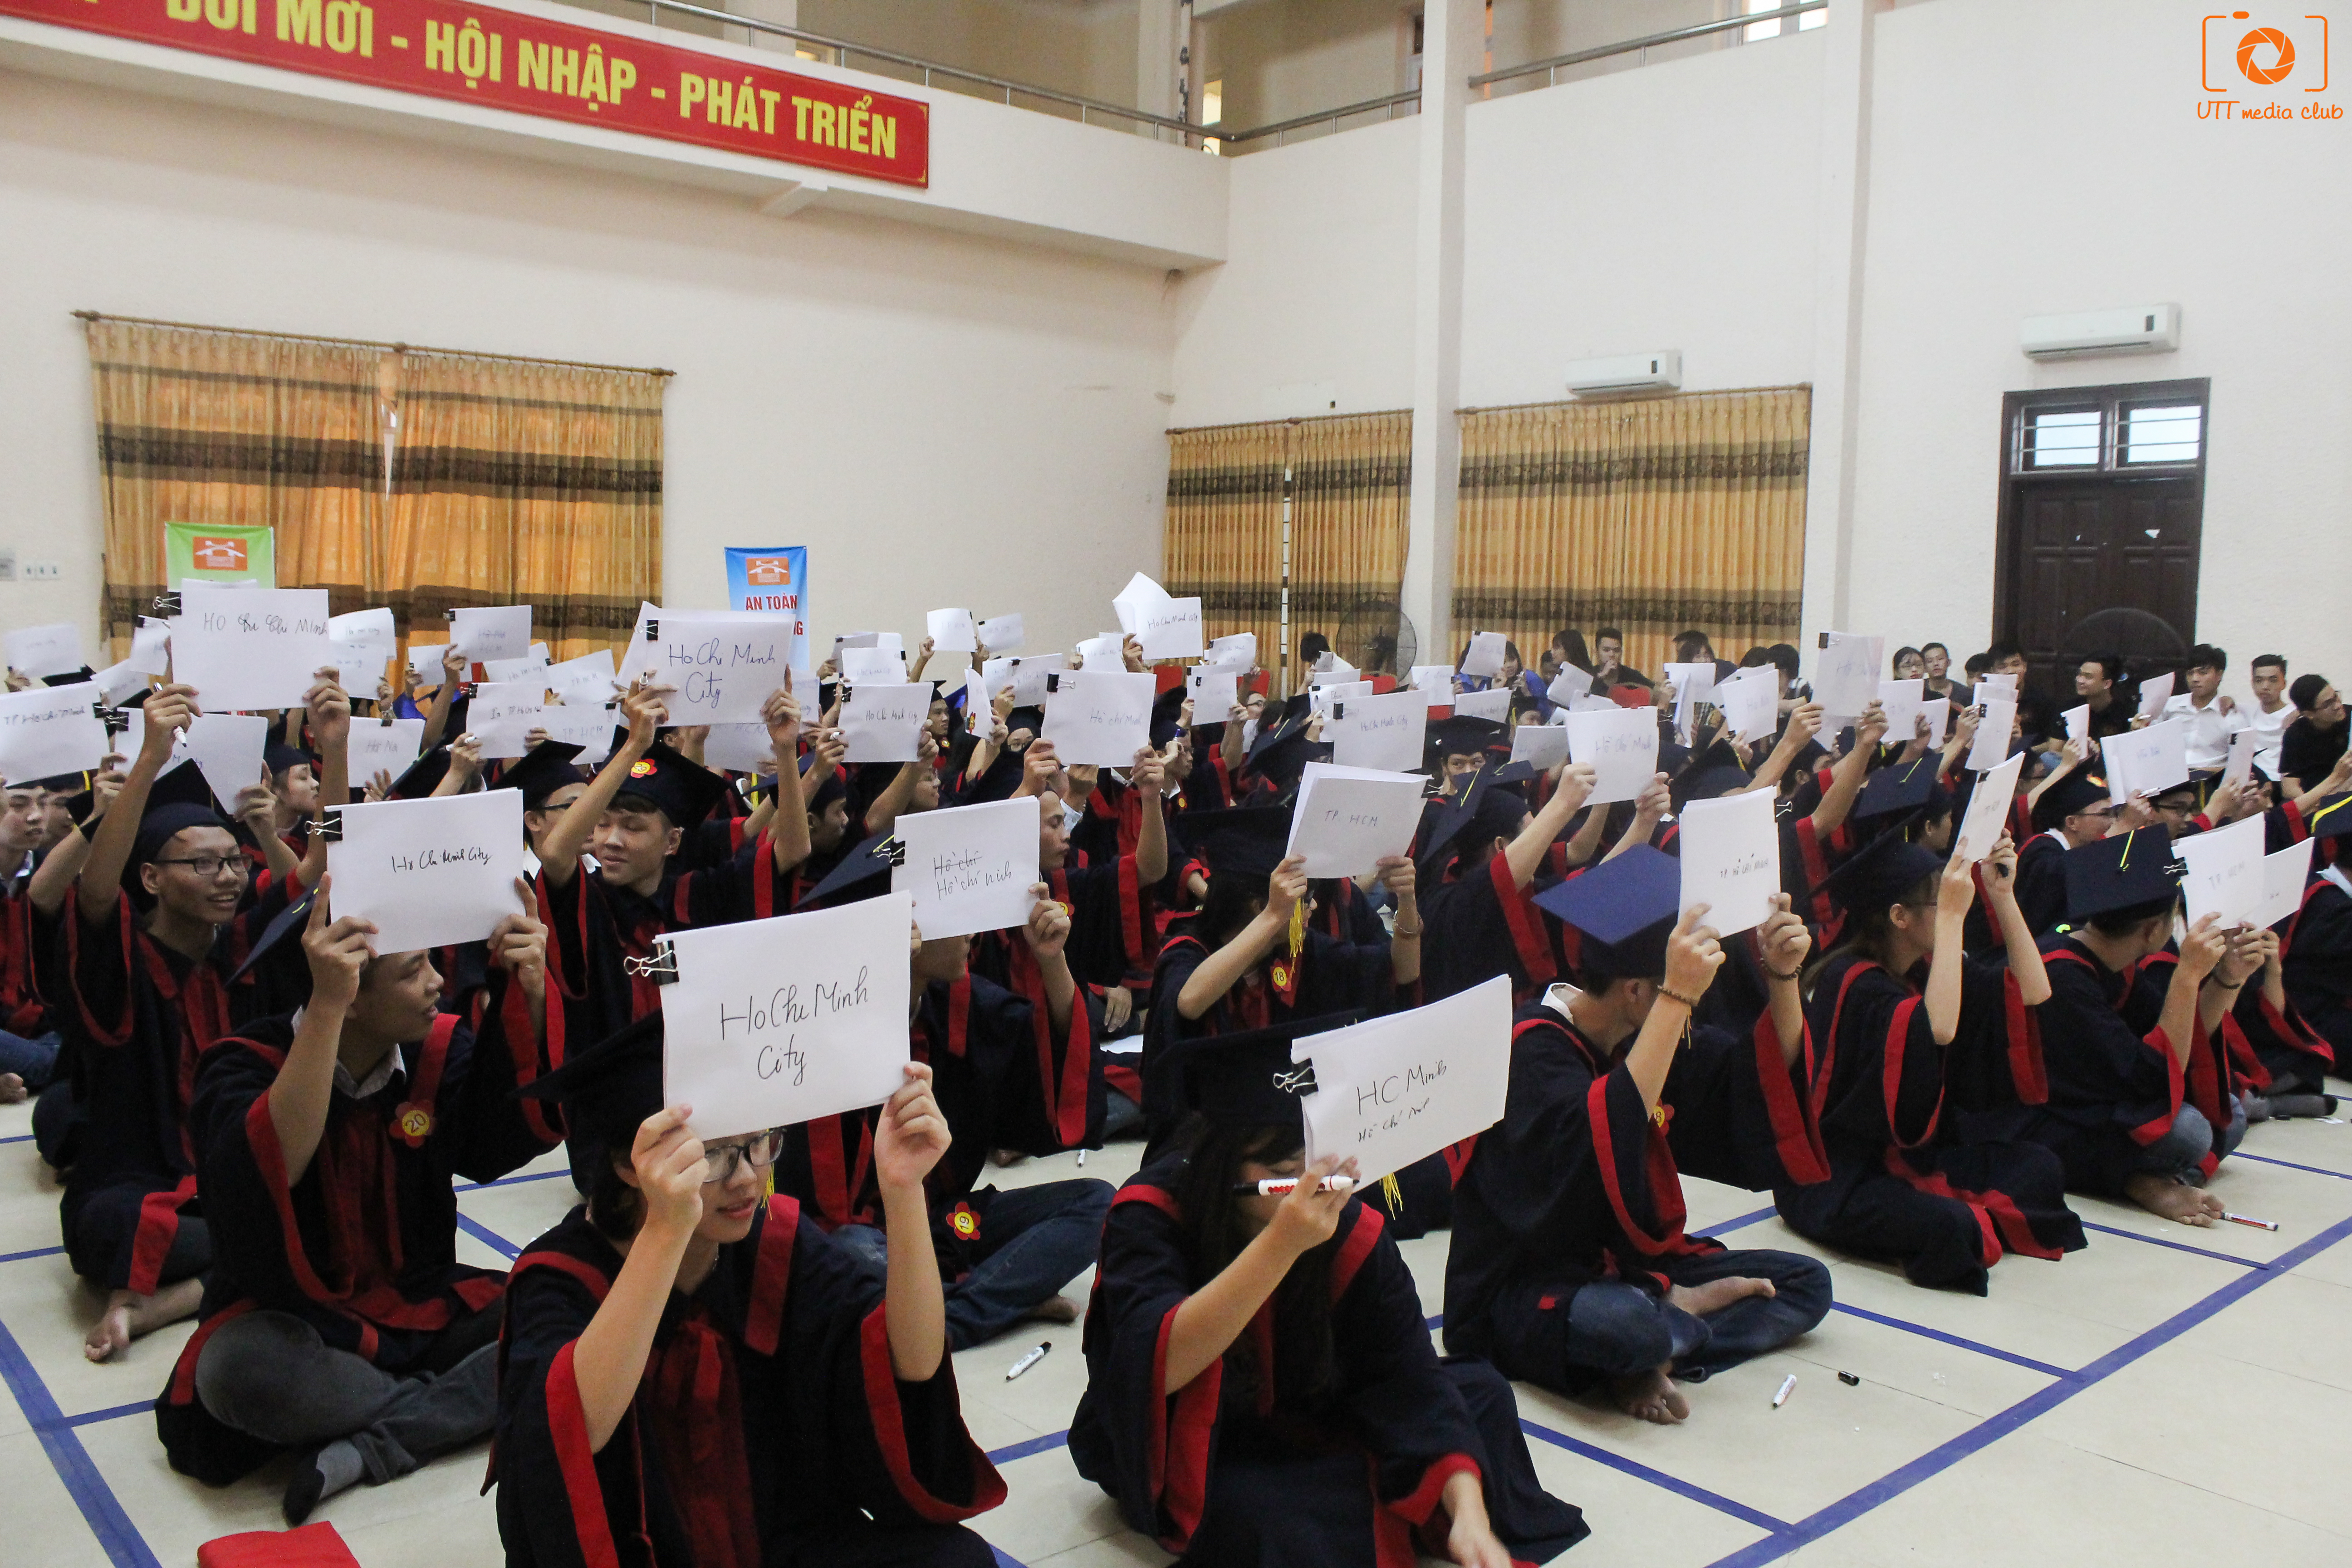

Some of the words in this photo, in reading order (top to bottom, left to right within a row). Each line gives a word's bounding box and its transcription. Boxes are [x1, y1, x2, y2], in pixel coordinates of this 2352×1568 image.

[426, 17, 502, 89] HỘI
[518, 44, 637, 111] NHẬP
[680, 72, 781, 135] PHÁT
[792, 95, 897, 159] TRIỂN
[745, 596, 763, 611] AN
[765, 592, 798, 610] TOÀN
[669, 643, 693, 667] Ho
[686, 671, 722, 709] City
[1274, 971, 1285, 982] 18
[720, 995, 765, 1041] Ho
[771, 985, 809, 1027] Chi
[814, 965, 869, 1018] Minh
[758, 1034, 807, 1087] City
[405, 1113, 426, 1134] 20
[958, 1215, 970, 1230] 19
